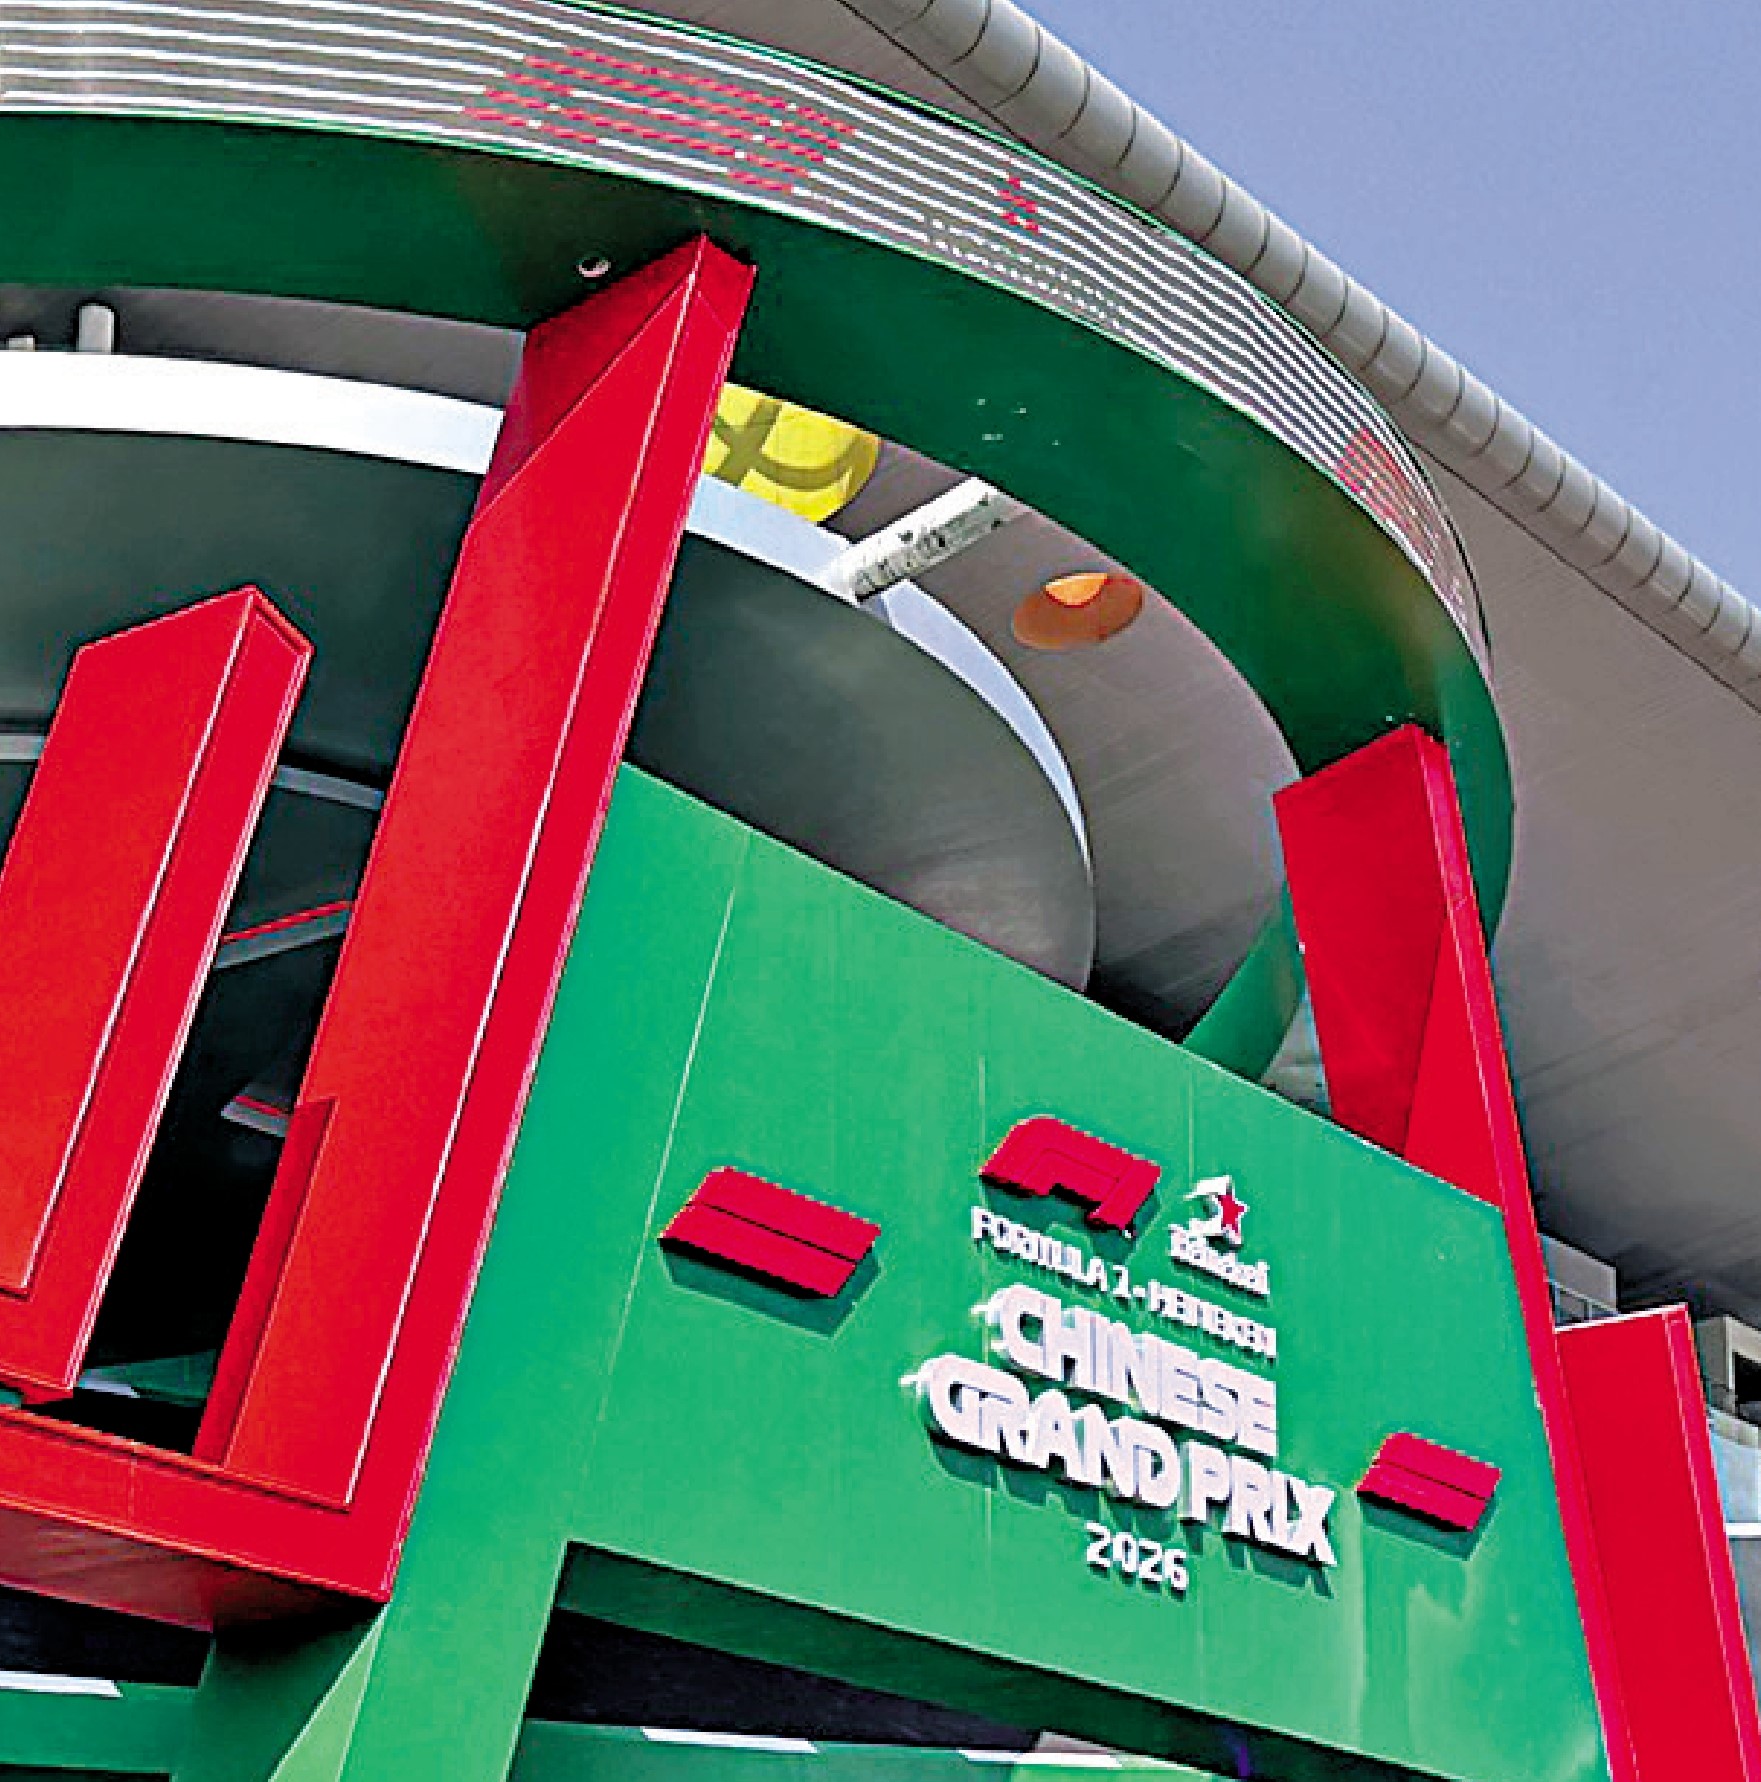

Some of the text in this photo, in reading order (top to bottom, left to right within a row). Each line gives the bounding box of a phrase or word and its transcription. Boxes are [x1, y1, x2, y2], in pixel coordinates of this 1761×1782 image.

[971, 1282, 1277, 1457] CHINESE
[899, 1353, 1337, 1567] GRAND PRIX
[1085, 1521, 1189, 1592] 2026
